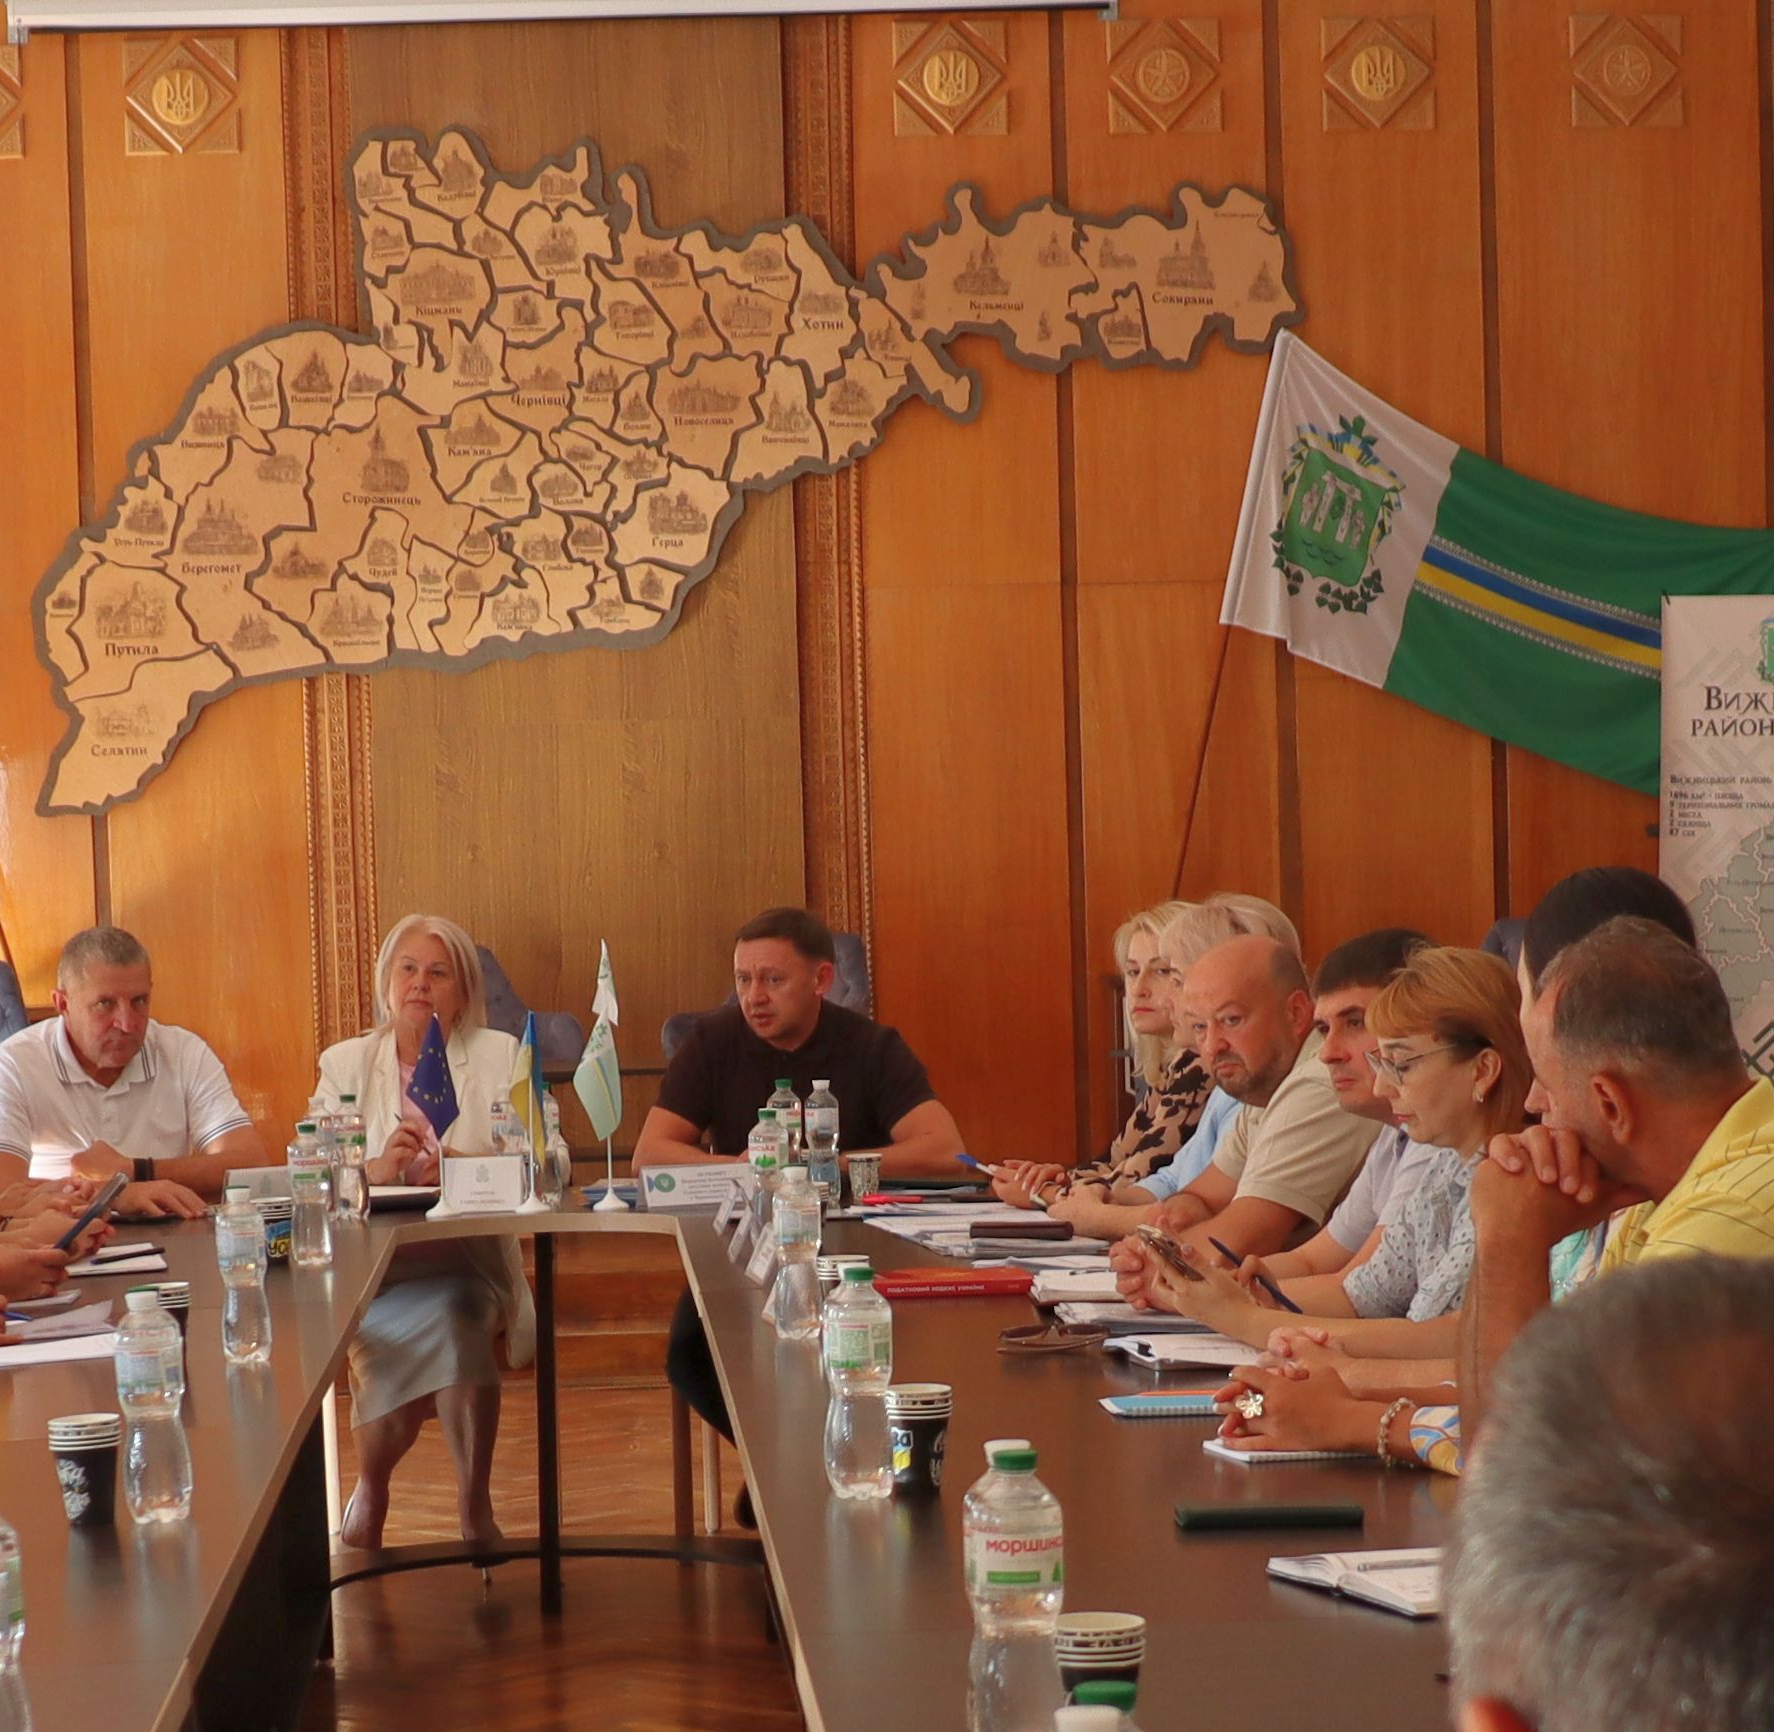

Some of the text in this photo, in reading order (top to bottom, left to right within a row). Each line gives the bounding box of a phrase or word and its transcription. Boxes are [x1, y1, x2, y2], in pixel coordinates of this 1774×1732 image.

[1152, 292, 1213, 306] Сокиряни
[415, 305, 463, 316] Кіцмань
[802, 317, 844, 330] Хотин
[511, 393, 567, 407] Чернівці
[674, 416, 734, 426] Новоселиця
[342, 492, 421, 505] Сторожинець
[181, 563, 242, 575] Берегомет
[105, 643, 159, 657] Путила
[91, 745, 147, 757] Селятин
